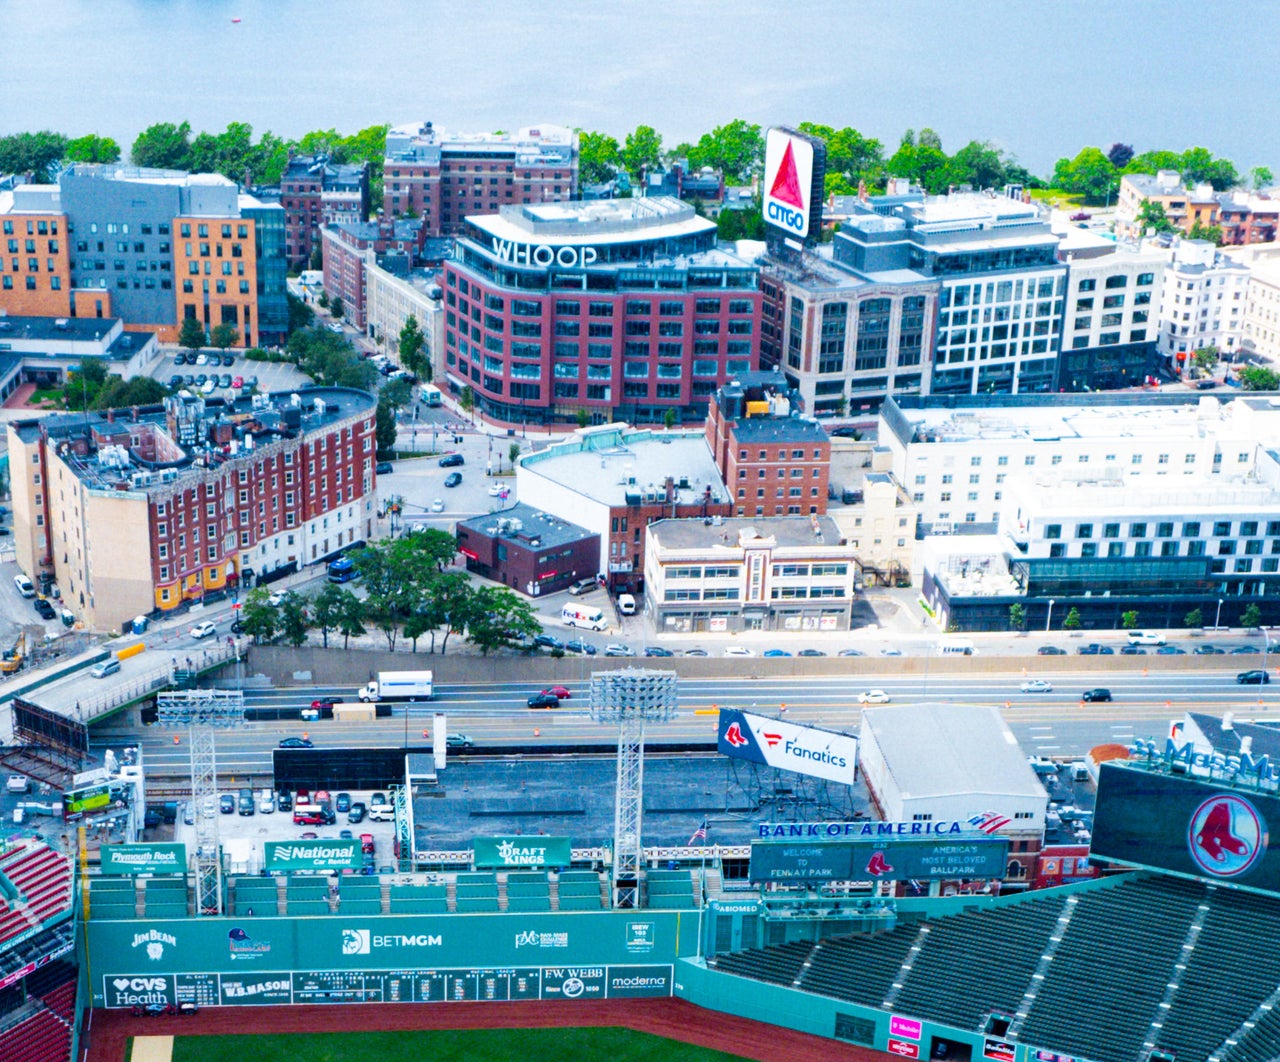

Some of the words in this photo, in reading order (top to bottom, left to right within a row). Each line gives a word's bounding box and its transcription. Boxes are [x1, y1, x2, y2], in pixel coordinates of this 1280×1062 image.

[768, 202, 803, 230] CITGO
[492, 237, 597, 268] WHOOP
[563, 609, 586, 621] FedEx
[785, 740, 846, 767] Fanatics
[759, 823, 819, 837] BANK
[827, 823, 854, 836] OF
[861, 821, 961, 835] AMERICA
[111, 852, 152, 863] Plymouth
[153, 851, 176, 861] Rock
[292, 846, 354, 860] National
[501, 847, 546, 857] DRAFT
[783, 849, 823, 857] WELCOME
[505, 855, 545, 865] KINGS
[771, 869, 807, 877] FENWAY
[809, 868, 833, 877] PARK
[930, 866, 975, 874] BALLPARK
[719, 905, 758, 913] ABIOMED
[131, 932, 150, 948] JIM
[150, 929, 176, 947] BEAM
[372, 934, 442, 947] BETMGM
[568, 968, 604, 978] WEBB
[130, 978, 167, 991] CVS
[612, 977, 665, 986] moderna
[116, 992, 167, 1005] Health
